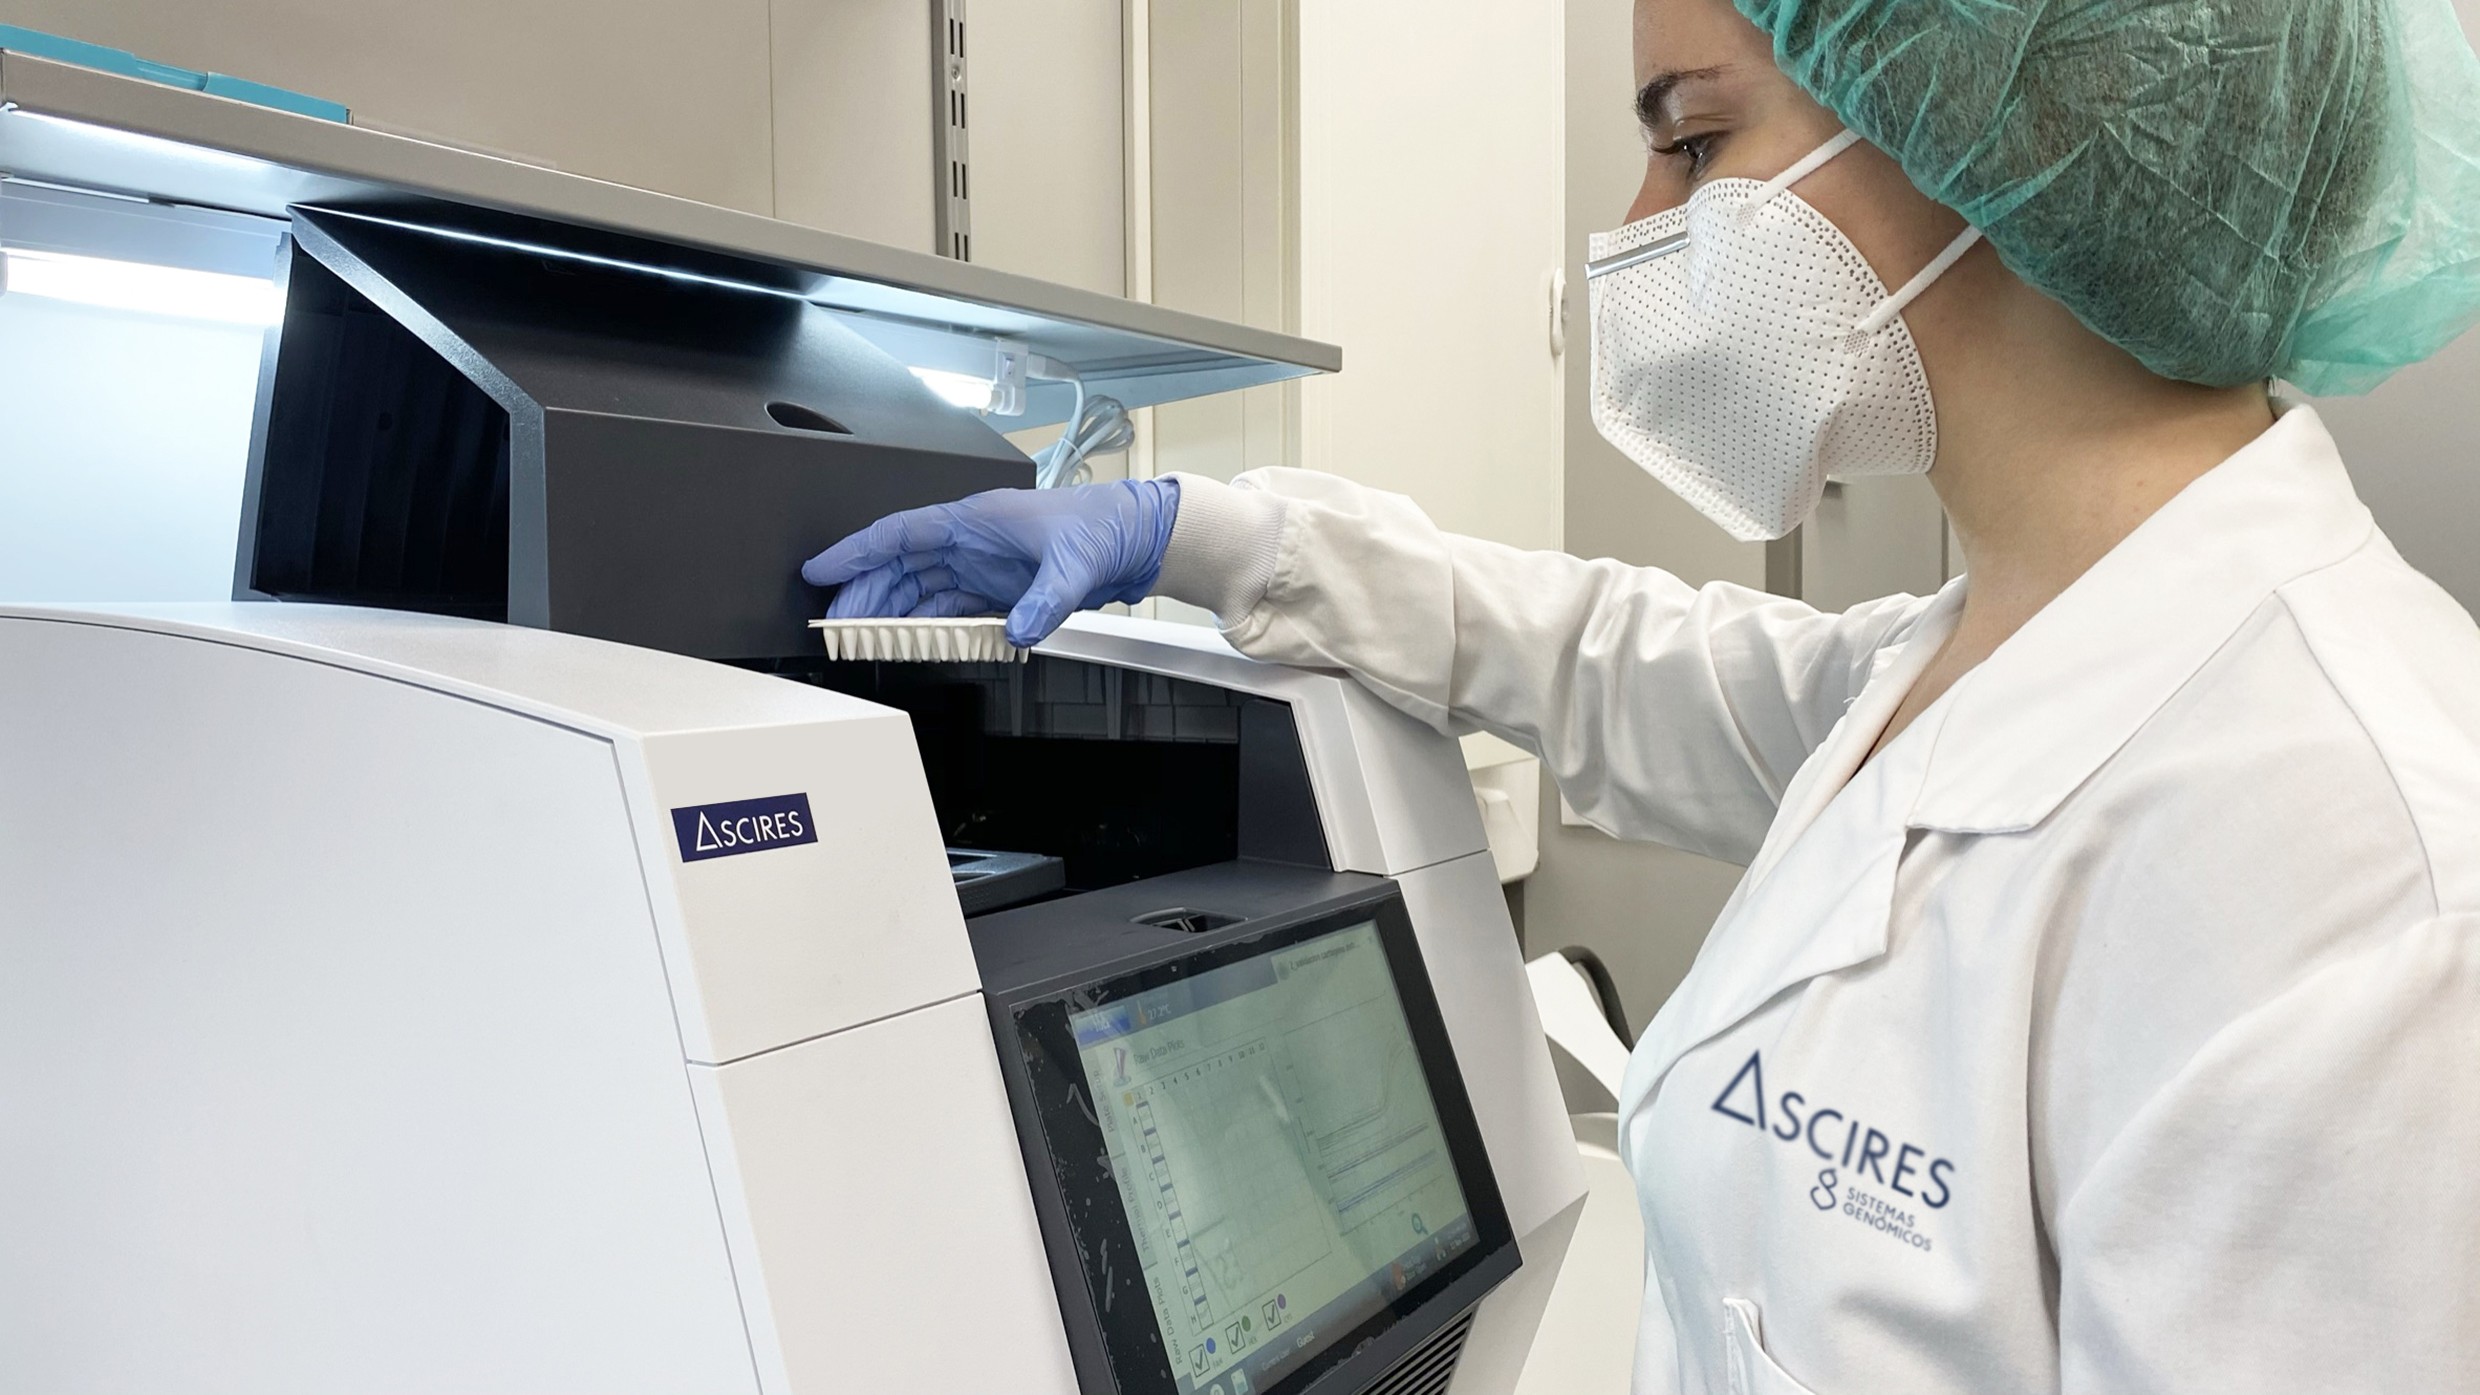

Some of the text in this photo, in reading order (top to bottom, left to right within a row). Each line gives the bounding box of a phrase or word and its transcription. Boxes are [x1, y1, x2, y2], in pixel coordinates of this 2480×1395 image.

[696, 811, 803, 851] ASCIRES
[1133, 1038, 1186, 1066] Raw Data Plots
[1103, 1104, 1115, 1133] Plate
[1710, 1049, 1955, 1209] ASCIRES
[1121, 1167, 1150, 1252] Thermal Profile
[1843, 1201, 1932, 1252] GENÓMICOS
[1846, 1187, 1915, 1228] SISTEMAS
[1152, 1276, 1183, 1365] Raw Data Plots
[1296, 1331, 1316, 1348] Guest
